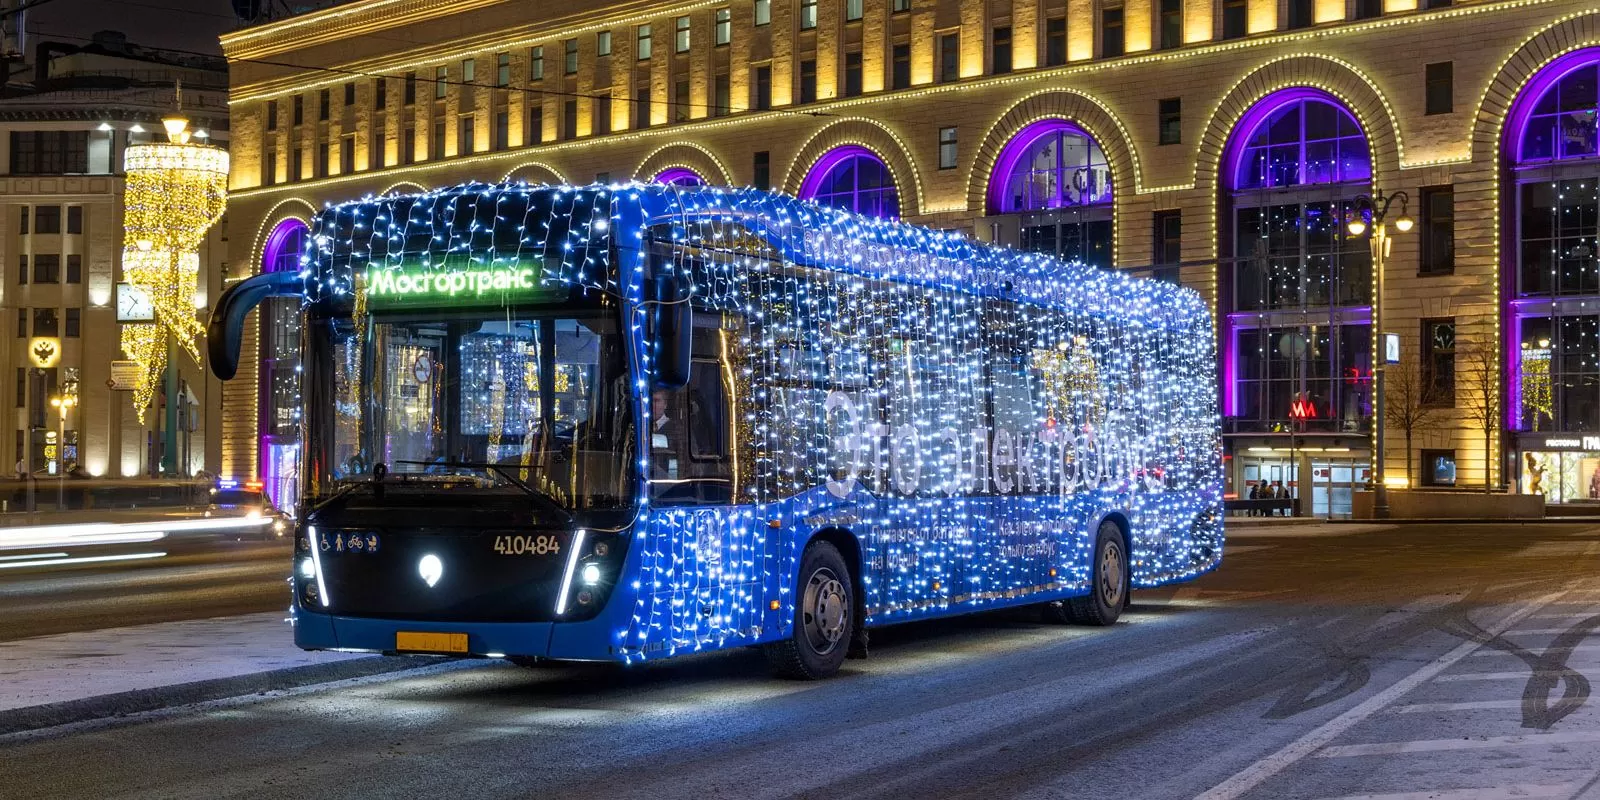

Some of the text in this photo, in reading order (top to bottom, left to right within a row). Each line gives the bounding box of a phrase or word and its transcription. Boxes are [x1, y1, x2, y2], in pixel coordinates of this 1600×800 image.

[370, 269, 533, 295] Мосгортранс
[824, 391, 921, 499] Это
[494, 535, 560, 555] 410484
